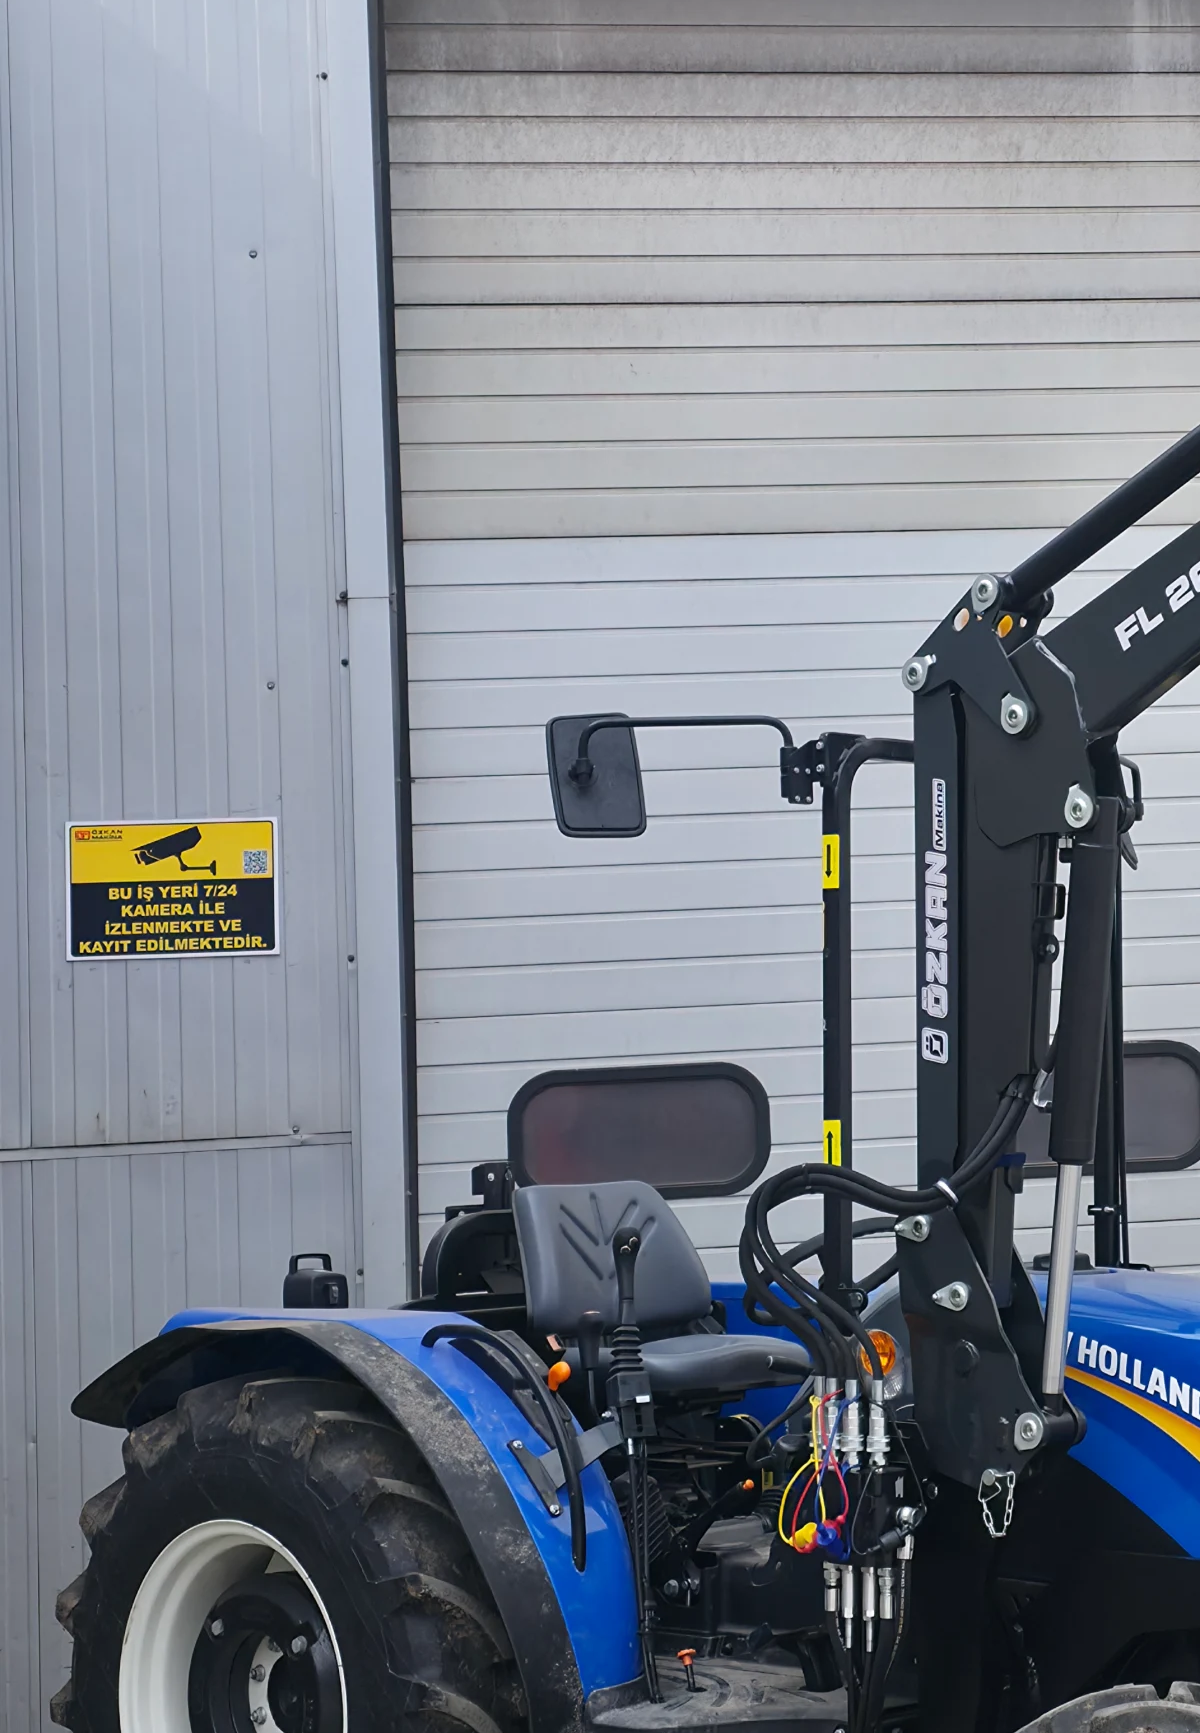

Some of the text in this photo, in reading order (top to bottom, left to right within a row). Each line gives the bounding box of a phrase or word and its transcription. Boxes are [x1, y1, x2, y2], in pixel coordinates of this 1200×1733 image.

[1114, 606, 1165, 651] FL
[108, 883, 238, 902] BU İŞ YERİ 7/24
[922, 851, 948, 1019] ÖZKAN
[935, 782, 944, 848] Makina
[121, 900, 226, 917] KAMERA İLE
[105, 919, 242, 936] İZLENMEKTE VE
[79, 934, 267, 953] KAYIT EDİLMEKTEDİR.
